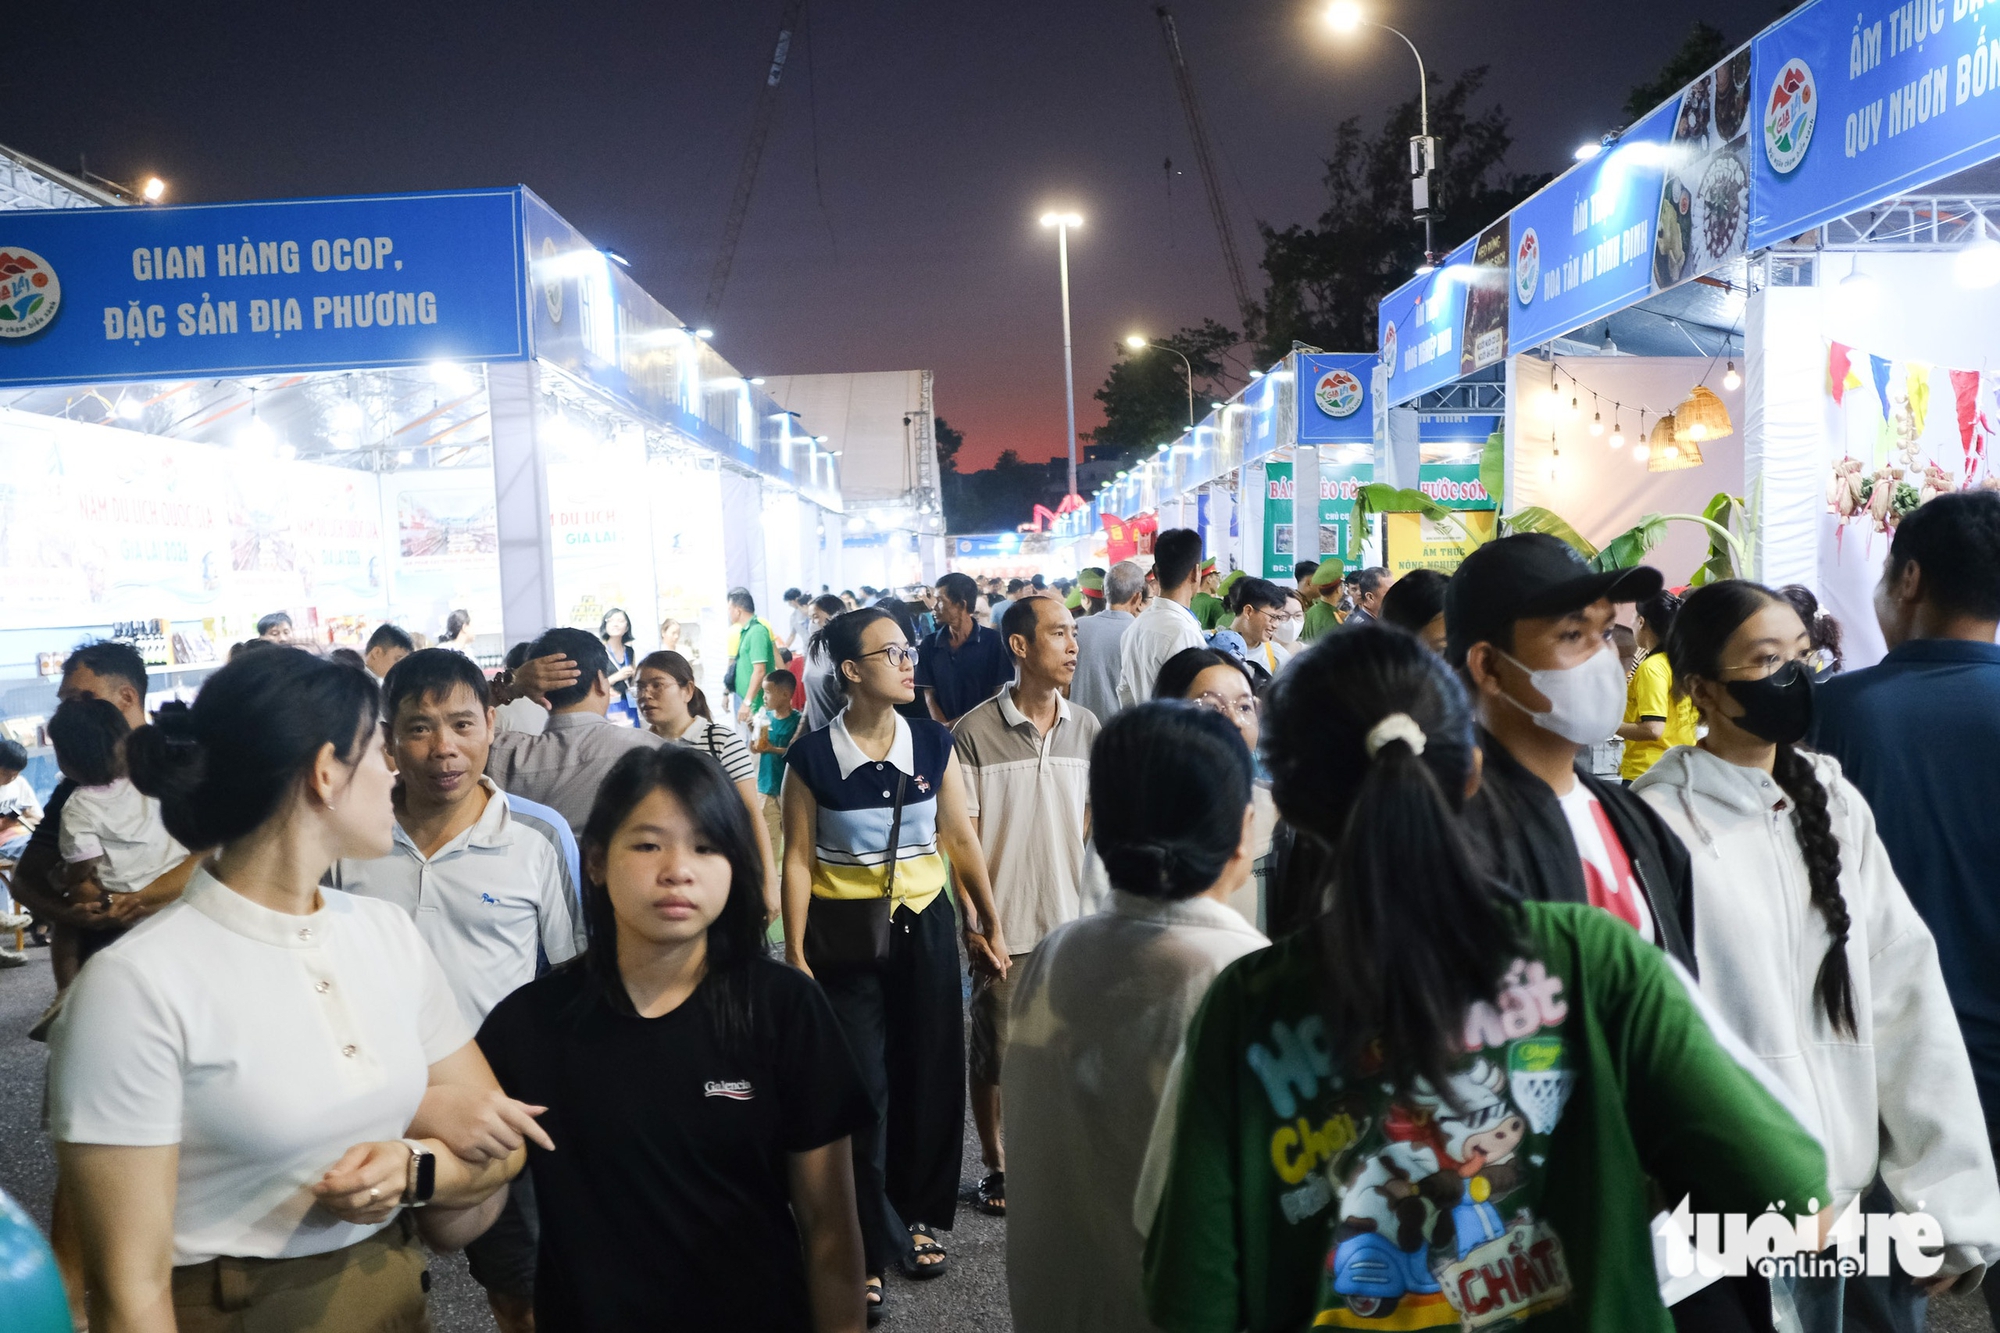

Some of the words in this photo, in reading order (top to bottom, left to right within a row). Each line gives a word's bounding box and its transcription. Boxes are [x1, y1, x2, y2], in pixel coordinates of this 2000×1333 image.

[1850, 12, 1882, 80] ẨM
[1845, 98, 1883, 158] QUY
[1888, 64, 1948, 139] NHƠN
[132, 245, 206, 281] GIAN
[217, 236, 300, 276] HÀNG
[311, 236, 403, 272] OCOP,
[1563, 255, 1579, 292] TÂN
[1581, 248, 1594, 284] AN
[1596, 234, 1620, 277] BÌNH
[1622, 219, 1648, 267] ĐỊNH
[103, 299, 166, 346] ĐẶC
[177, 292, 238, 337] SẢN
[249, 297, 302, 339] ĐỊA
[313, 291, 437, 329] PHƯƠNG
[1319, 476, 1339, 500] ÈO
[560, 512, 579, 526] DU
[565, 532, 591, 545] GIA
[595, 531, 617, 543] LAI
[1423, 544, 1437, 557] ẨM
